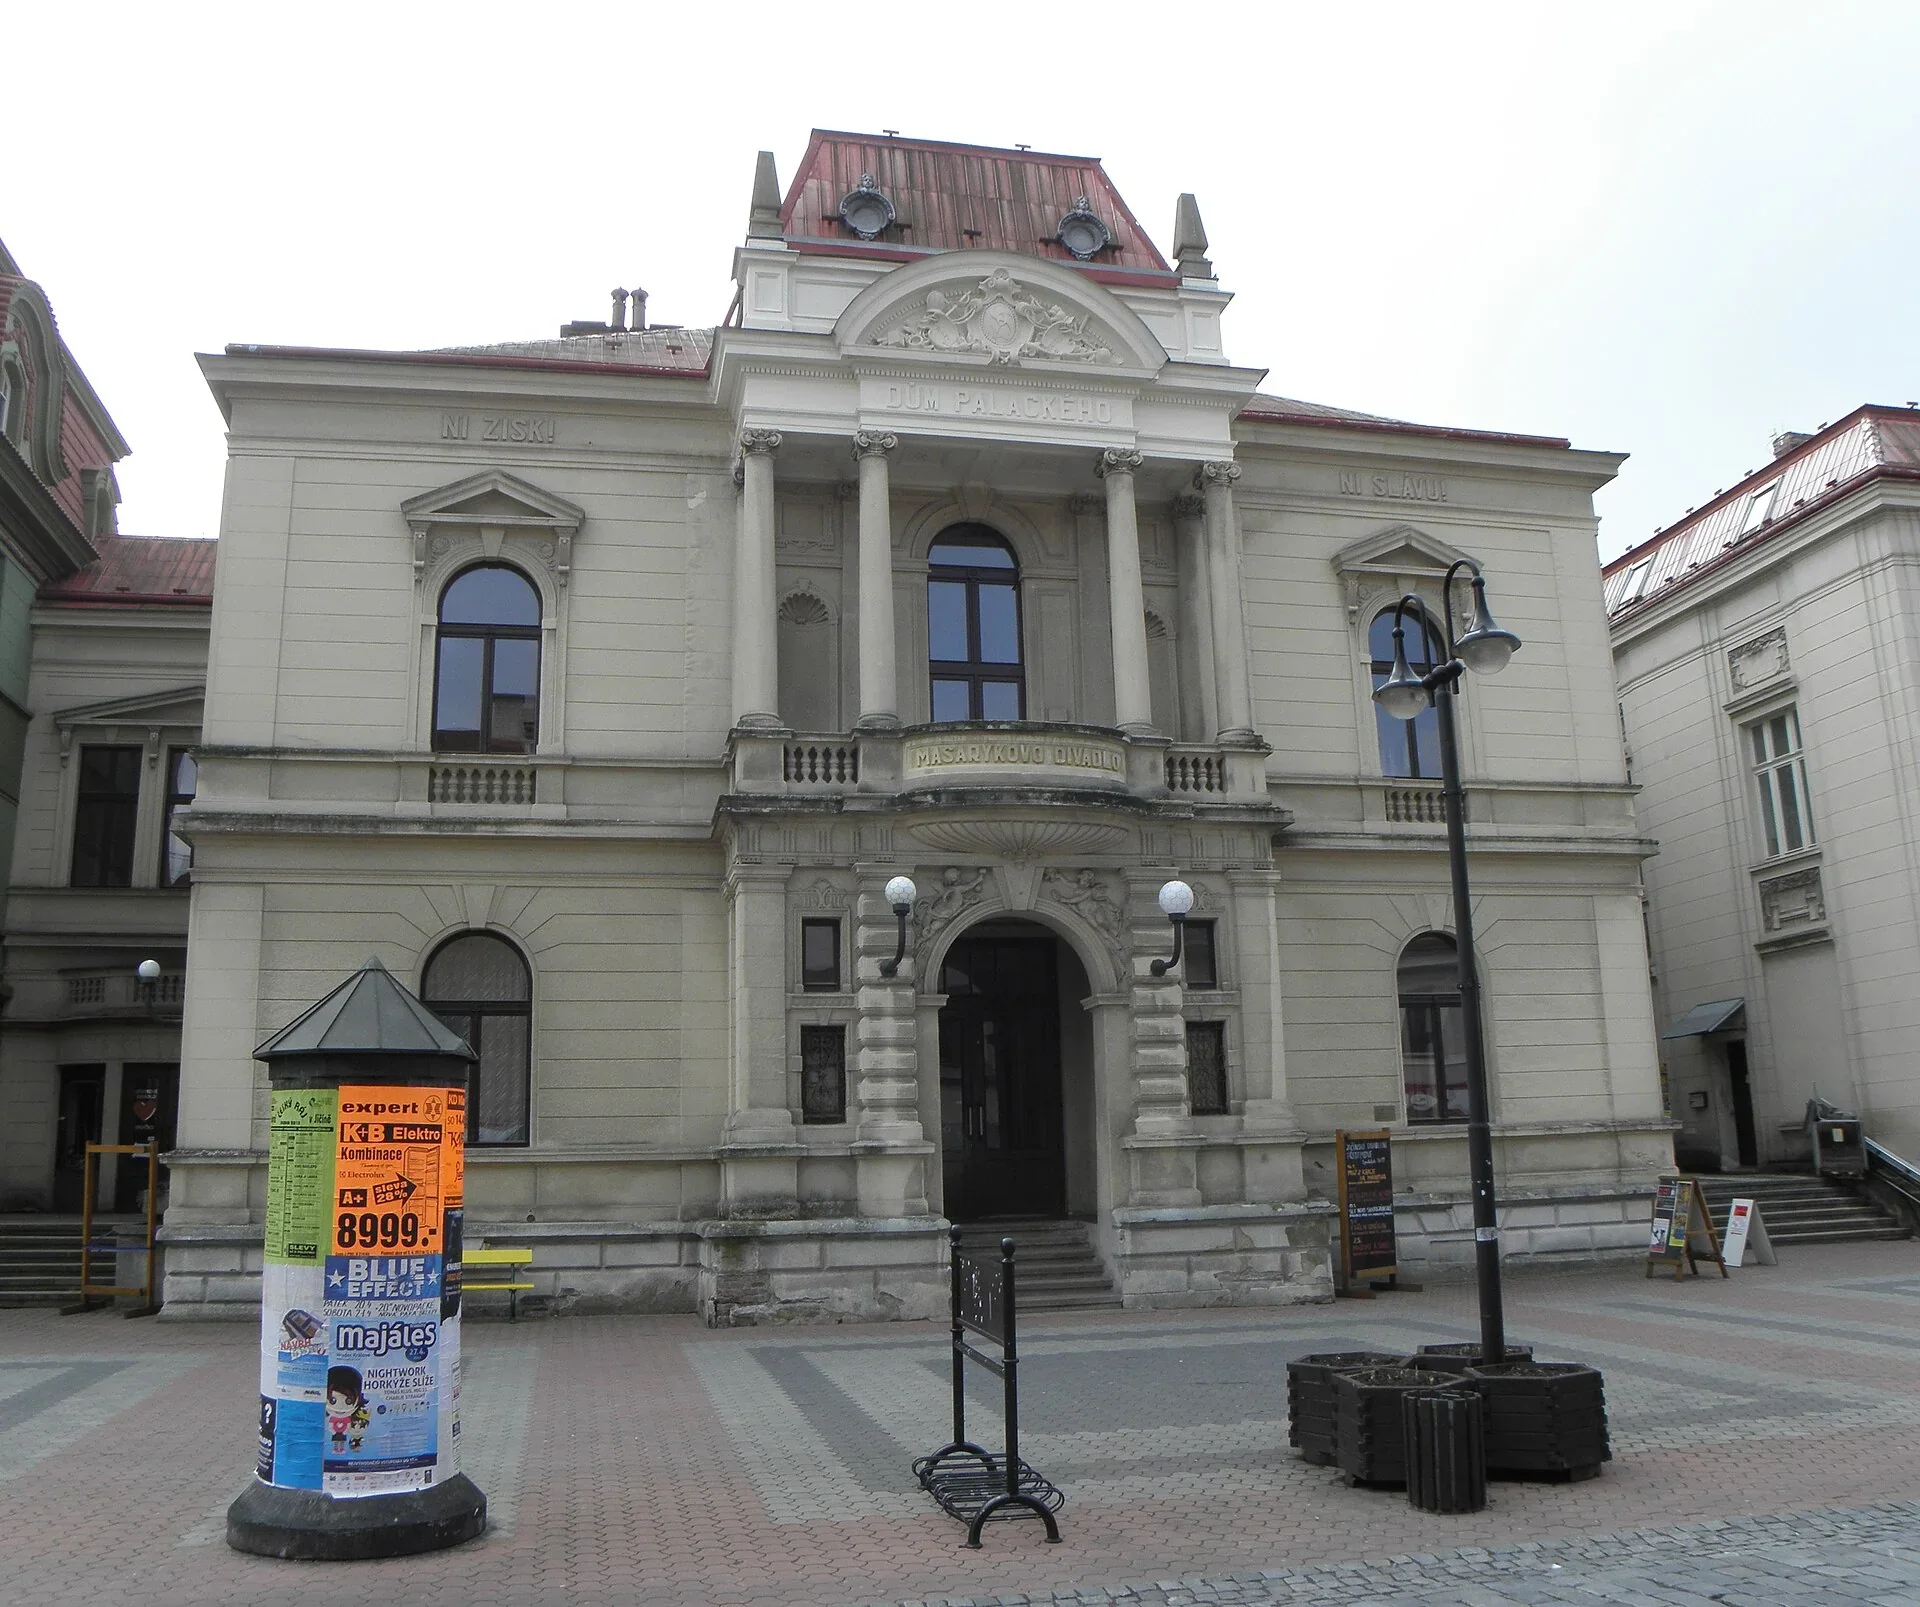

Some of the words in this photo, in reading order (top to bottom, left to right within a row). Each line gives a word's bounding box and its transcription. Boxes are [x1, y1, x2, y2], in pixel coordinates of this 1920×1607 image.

[886, 381, 941, 412] DŮM
[954, 391, 1112, 424] PALACKÉHO
[441, 415, 469, 439] NI
[483, 418, 556, 443] ZISK!
[1339, 471, 1361, 495] NI
[1371, 471, 1447, 502] SLÁVU!
[916, 744, 1045, 767] MASARYKOVO
[1054, 747, 1121, 772] DIVADLO
[342, 1102, 419, 1116] expert
[343, 1123, 385, 1142] K+B
[392, 1126, 441, 1141] Elektro
[340, 1146, 403, 1161] Kombinace
[347, 1170, 386, 1179] Electrolux
[374, 1180, 409, 1195] sleva
[376, 1188, 409, 1204] 28%
[342, 1190, 365, 1205] A+
[348, 1258, 425, 1282] BLUE
[347, 1280, 424, 1298] EFFECT
[337, 1322, 436, 1356] majáles
[367, 1366, 426, 1378] NIGHTWORK
[364, 1377, 410, 1390] HORKÝŽE
[412, 1374, 434, 1387] SLÍŽE
